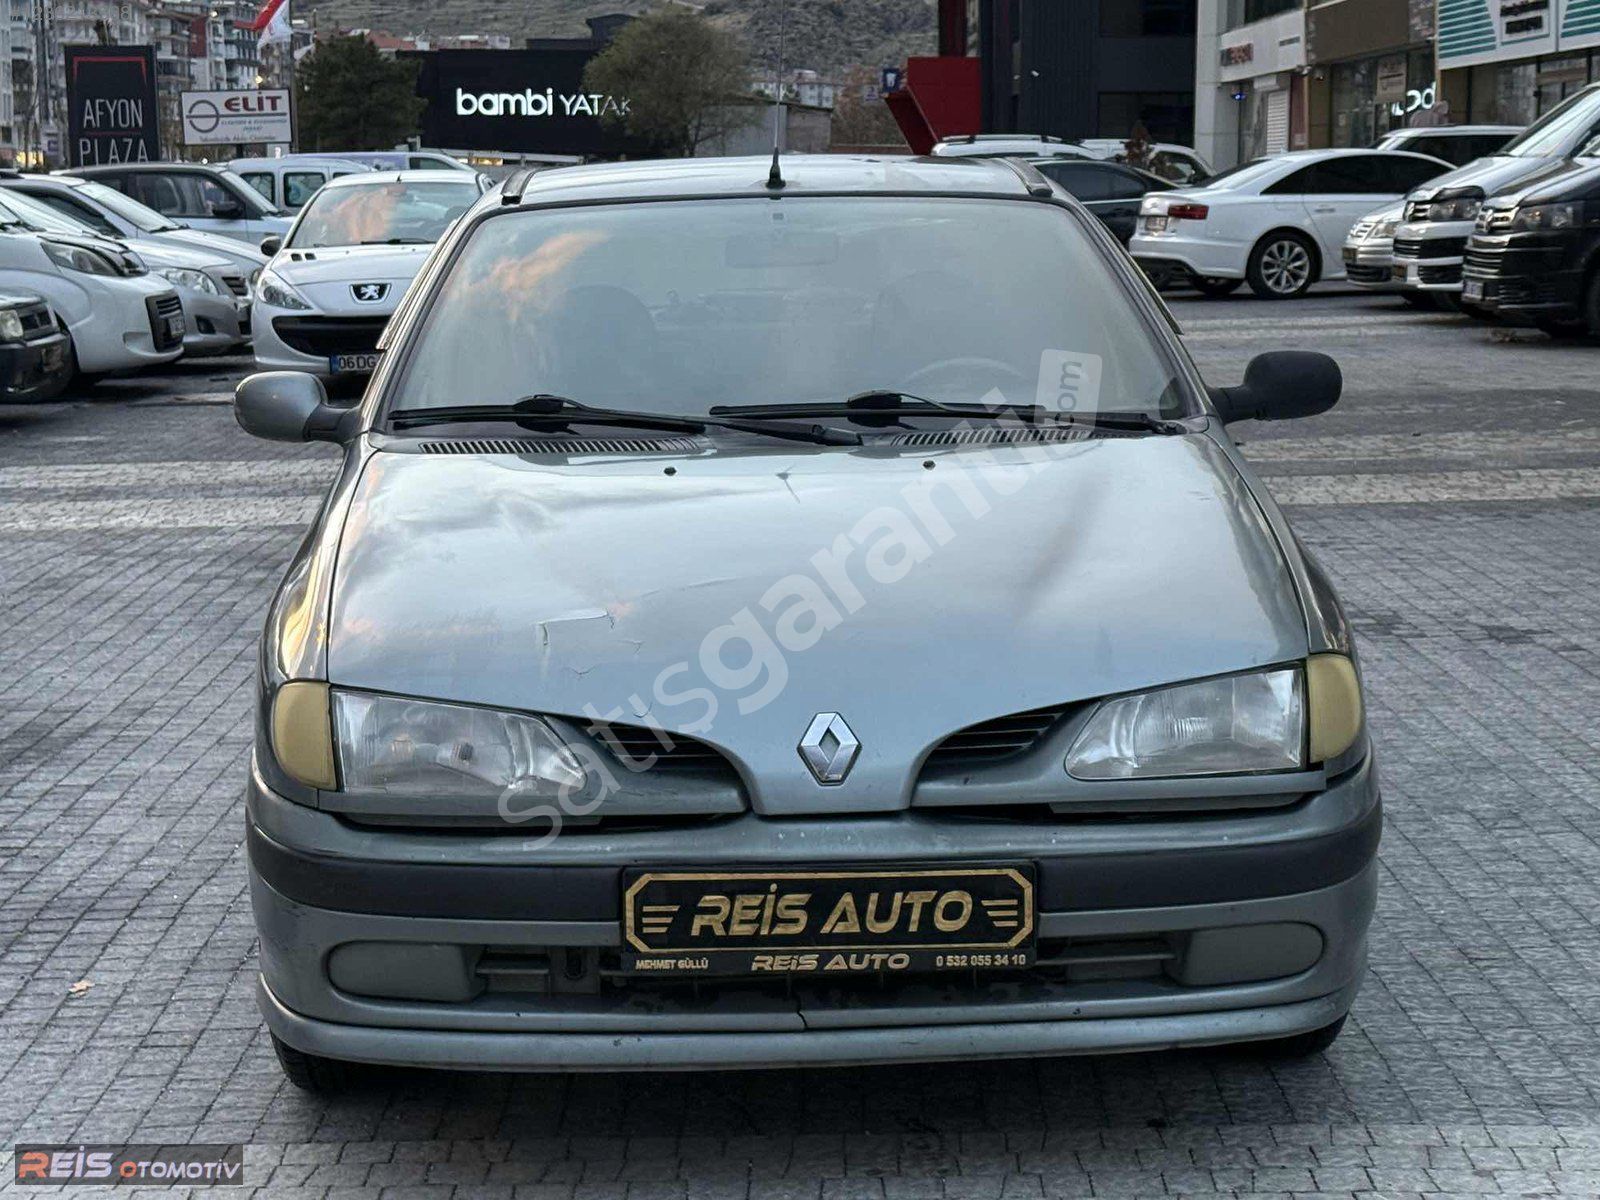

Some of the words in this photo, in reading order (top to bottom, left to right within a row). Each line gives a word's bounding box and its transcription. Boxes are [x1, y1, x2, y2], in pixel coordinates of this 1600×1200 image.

[83, 98, 143, 128] AFYON
[456, 87, 553, 116] bambi
[691, 883, 812, 936] REİS
[820, 889, 974, 934] AUTO
[635, 959, 677, 970] MEHMET
[678, 957, 709, 969] GÜLLÜ
[751, 953, 819, 971] REİS
[823, 953, 910, 970] AUTO
[936, 955, 943, 967] 0
[946, 955, 968, 967] 532
[970, 955, 991, 967] 055
[994, 954, 1009, 966] 34
[1011, 954, 1026, 965] 10
